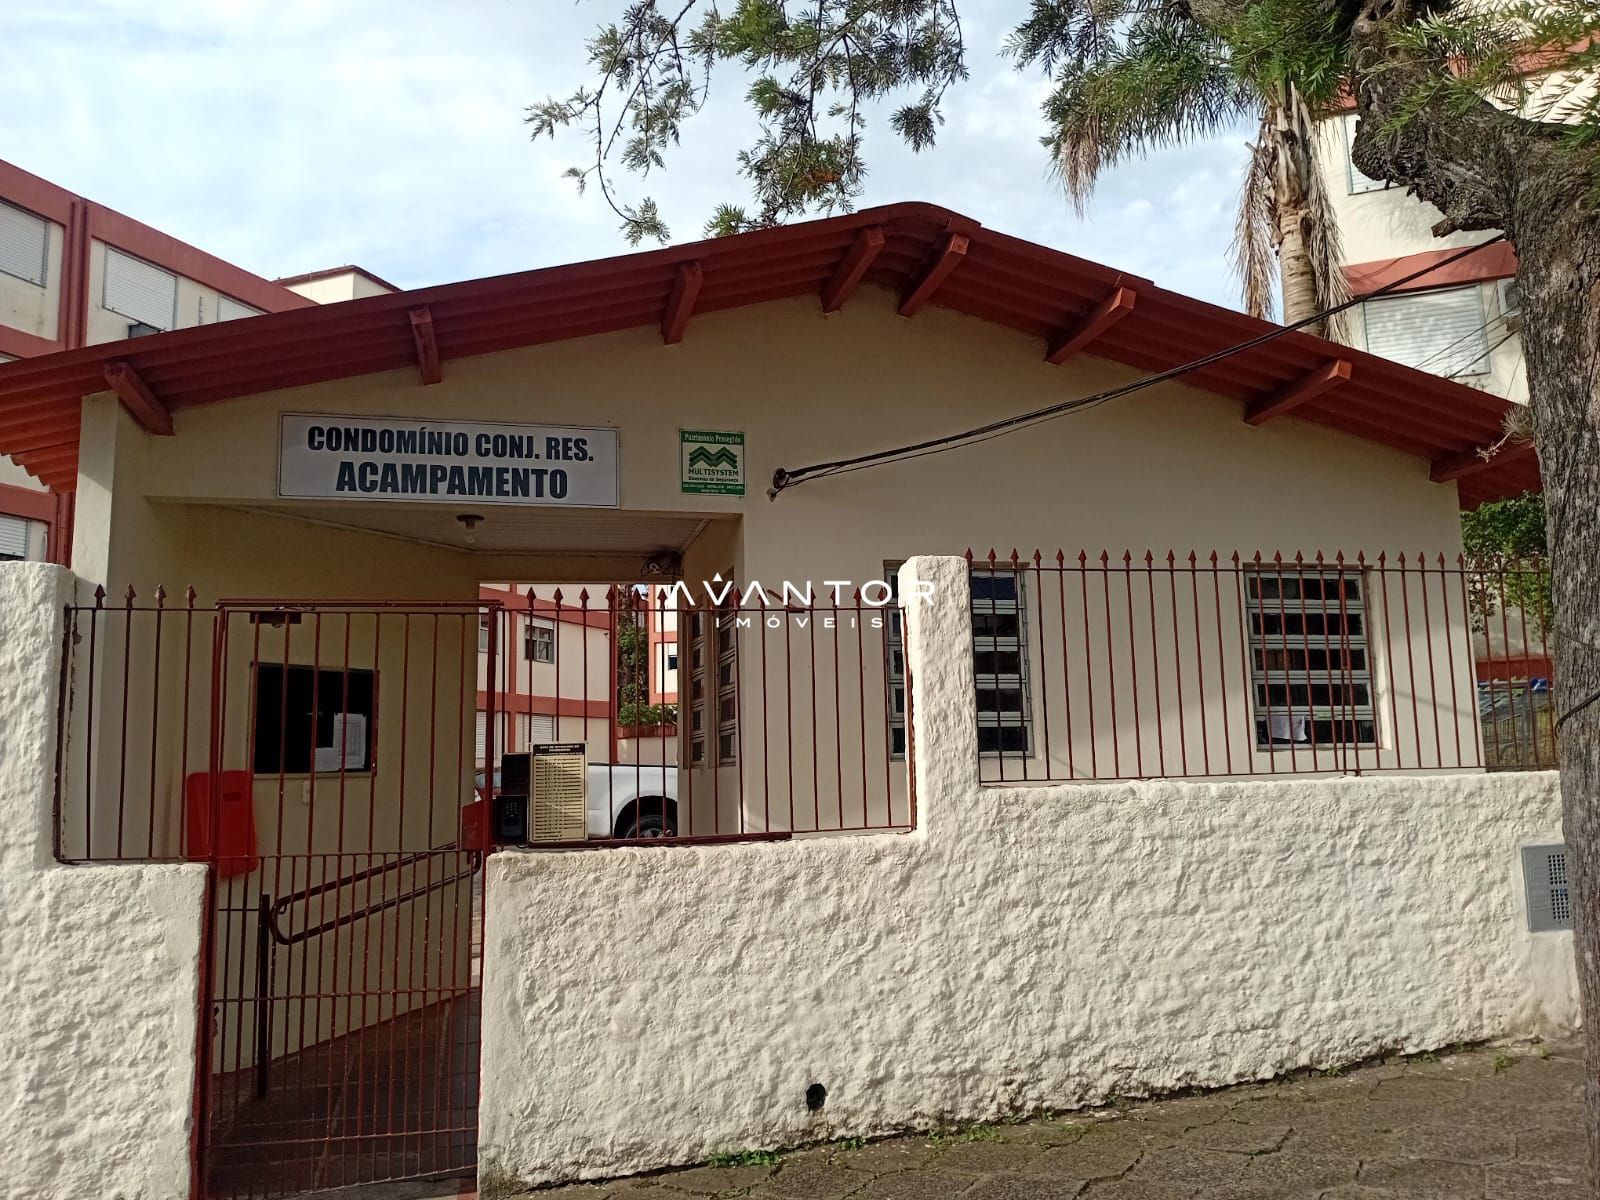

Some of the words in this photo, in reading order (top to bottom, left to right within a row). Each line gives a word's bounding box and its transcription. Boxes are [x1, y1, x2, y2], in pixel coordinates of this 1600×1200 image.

[308, 425, 469, 457] CONDOMÍNIO
[475, 433, 540, 460] CONJ.
[545, 437, 594, 462] RES.
[335, 461, 568, 500] ACAMPAMENTO
[688, 468, 739, 477] MULTISYSTEM
